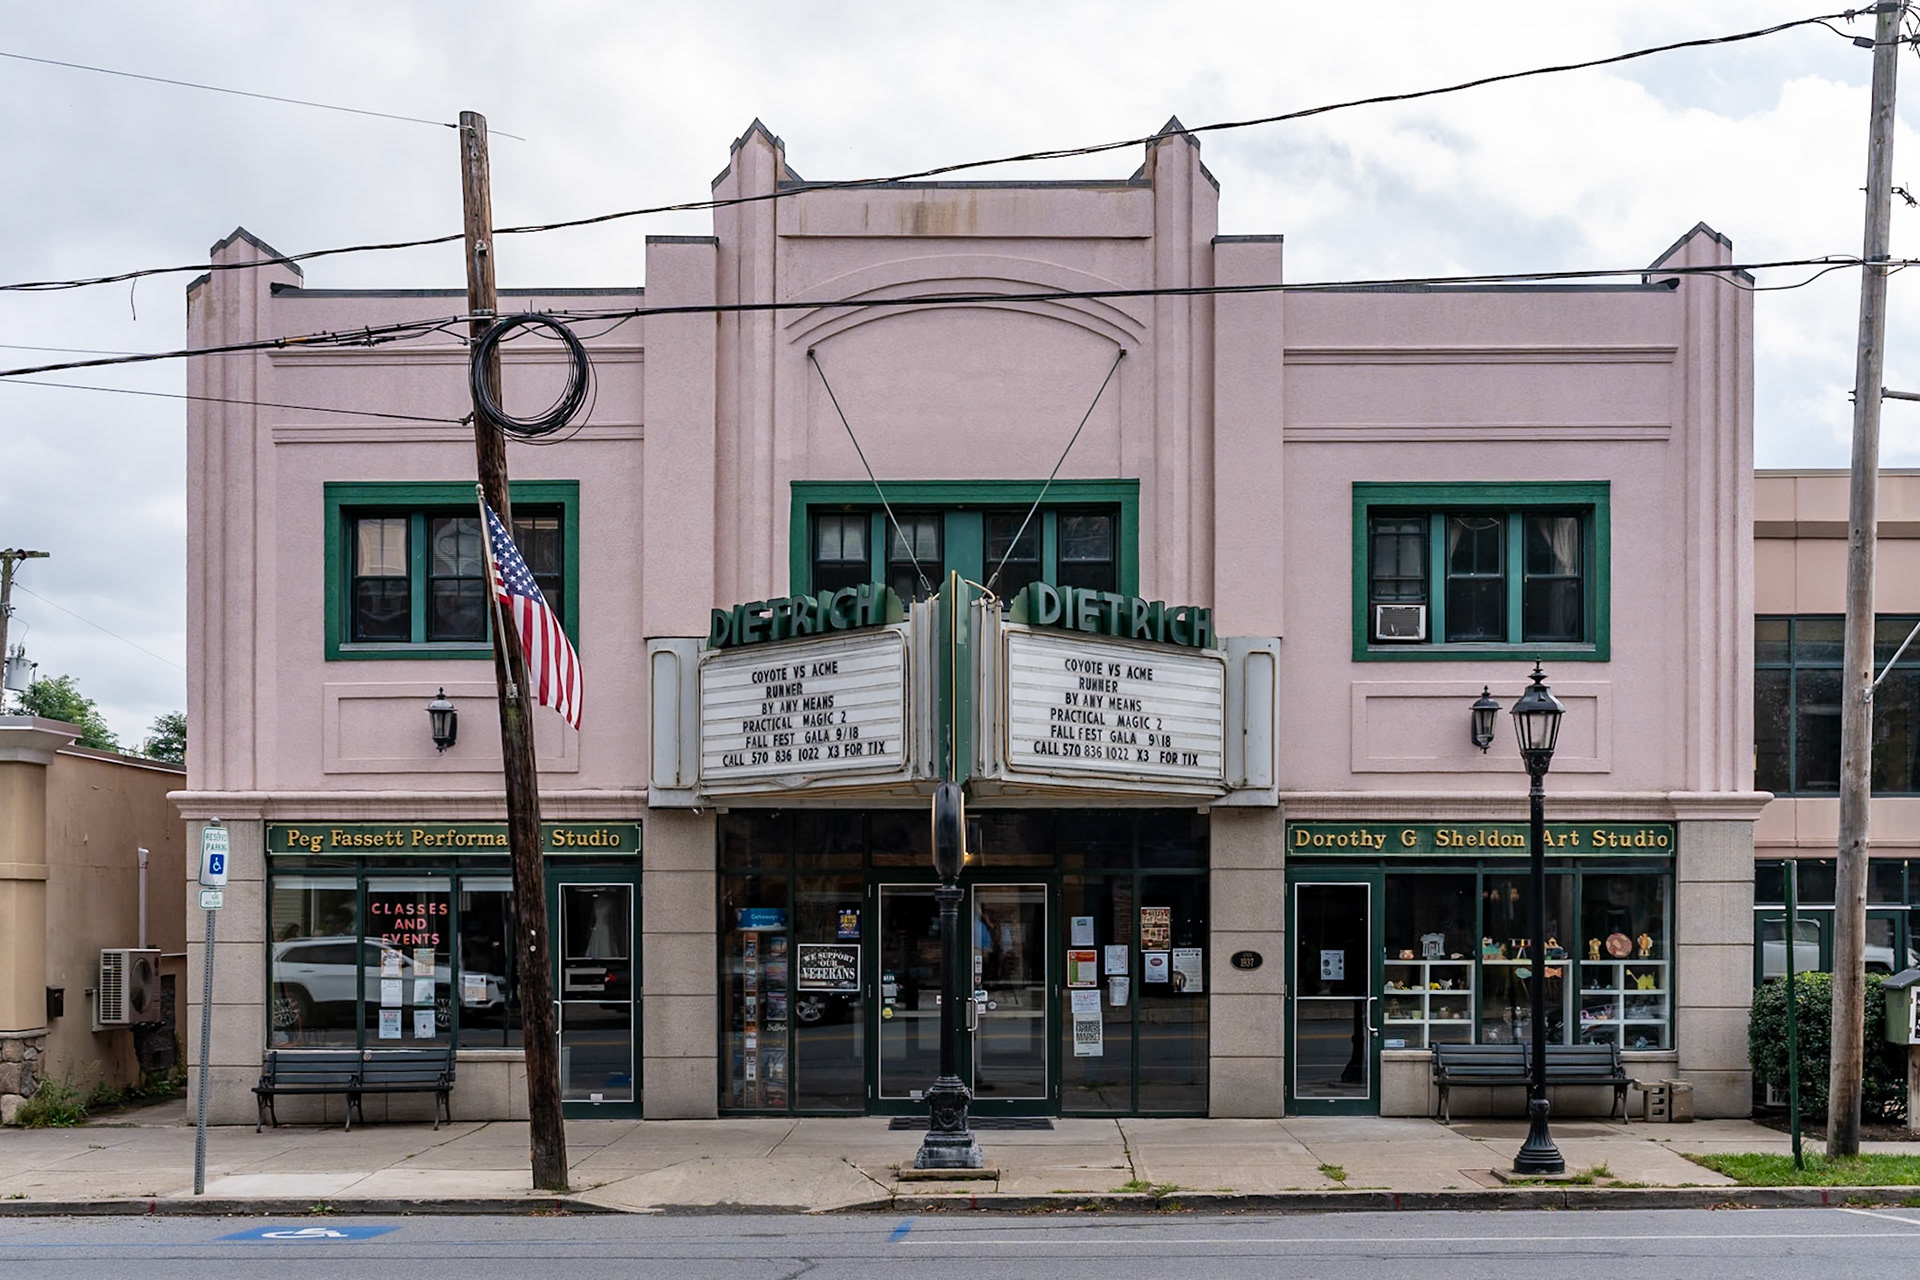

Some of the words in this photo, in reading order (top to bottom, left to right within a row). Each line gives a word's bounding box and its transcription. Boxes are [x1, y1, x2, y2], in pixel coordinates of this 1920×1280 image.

[711, 582, 886, 648] DIETRICH
[1029, 581, 1212, 648] DIETRICH
[752, 666, 787, 684] COYOTE
[793, 665, 806, 678] VS
[812, 661, 838, 677] ACME
[1064, 658, 1103, 675] COYOTE
[1108, 664, 1121, 677] VS
[1126, 665, 1153, 681] ACME
[766, 683, 803, 698] RUNNER
[1079, 677, 1118, 693] RUNNER
[761, 702, 774, 715] BY
[780, 700, 798, 713] ANY
[802, 695, 834, 711] MEANS
[1065, 693, 1078, 706] BY
[1083, 694, 1103, 709] ANY
[1109, 696, 1142, 712] MEANS
[742, 717, 793, 733] PRACTICAL
[803, 712, 833, 726] MAGIC
[840, 711, 847, 723] 2
[1050, 708, 1105, 726] PRACTICAL
[1117, 714, 1150, 730] MAGIC
[1156, 718, 1163, 730] 2
[746, 735, 768, 749] FALL
[773, 733, 795, 747] FEST
[804, 730, 830, 744] GALA
[836, 727, 859, 741] 9/18
[1050, 725, 1075, 740] FALL
[1078, 727, 1103, 742] FEST
[1110, 730, 1137, 745] GALA
[722, 752, 745, 767] CALL
[752, 750, 769, 765] 570
[775, 749, 792, 763] 836
[798, 748, 819, 762] 1022
[827, 745, 840, 758] X3
[844, 743, 863, 757] FOR
[868, 741, 886, 755] TIX
[1034, 741, 1060, 756] CALL
[1063, 743, 1081, 757] 570
[1084, 745, 1103, 758] 836
[1106, 747, 1129, 761] 1022
[1137, 749, 1149, 762] X3
[1159, 751, 1178, 765] FOR
[1183, 752, 1199, 767] TIX
[287, 829, 324, 852] Peg
[330, 829, 405, 847] Fassett
[411, 830, 544, 847] Performa
[552, 829, 620, 847] Studio
[1294, 829, 1387, 850] Dorothy
[1401, 829, 1418, 847] G
[1435, 829, 1526, 847] Sheldon
[1543, 829, 1580, 847] Art
[1592, 829, 1669, 848] Studio
[371, 903, 448, 915] CLASSES
[394, 918, 428, 930] AND
[381, 933, 440, 945] EVENTS
[803, 953, 817, 962] WE
[818, 952, 856, 963] SUPPORT
[801, 967, 856, 980] VETERANS
